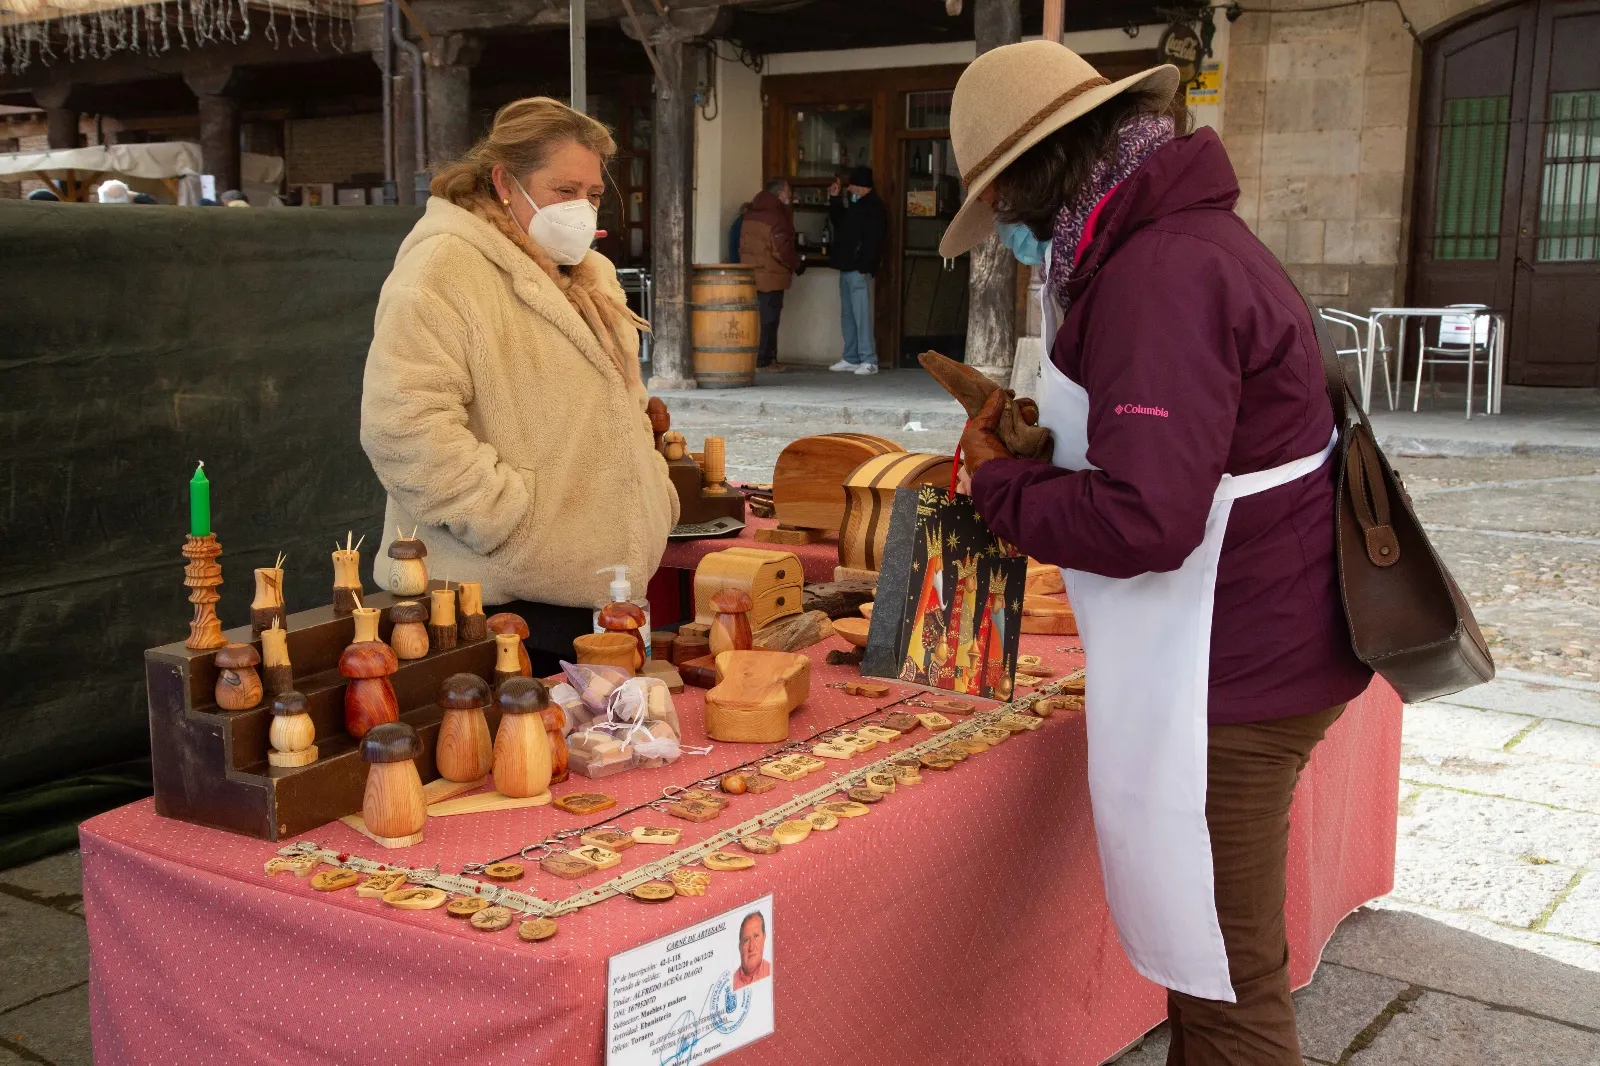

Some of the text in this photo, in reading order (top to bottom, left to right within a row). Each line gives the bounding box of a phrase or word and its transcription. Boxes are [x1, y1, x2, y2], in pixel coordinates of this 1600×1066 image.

[1124, 403, 1169, 418] Columbia
[666, 936, 687, 952] CARNÉ
[697, 922, 726, 939] ARTESANO
[633, 983, 662, 999] ALFREDO
[641, 1006, 662, 1018] Muebles
[667, 996, 686, 1007] madera
[631, 1032, 653, 1045] Tornero
